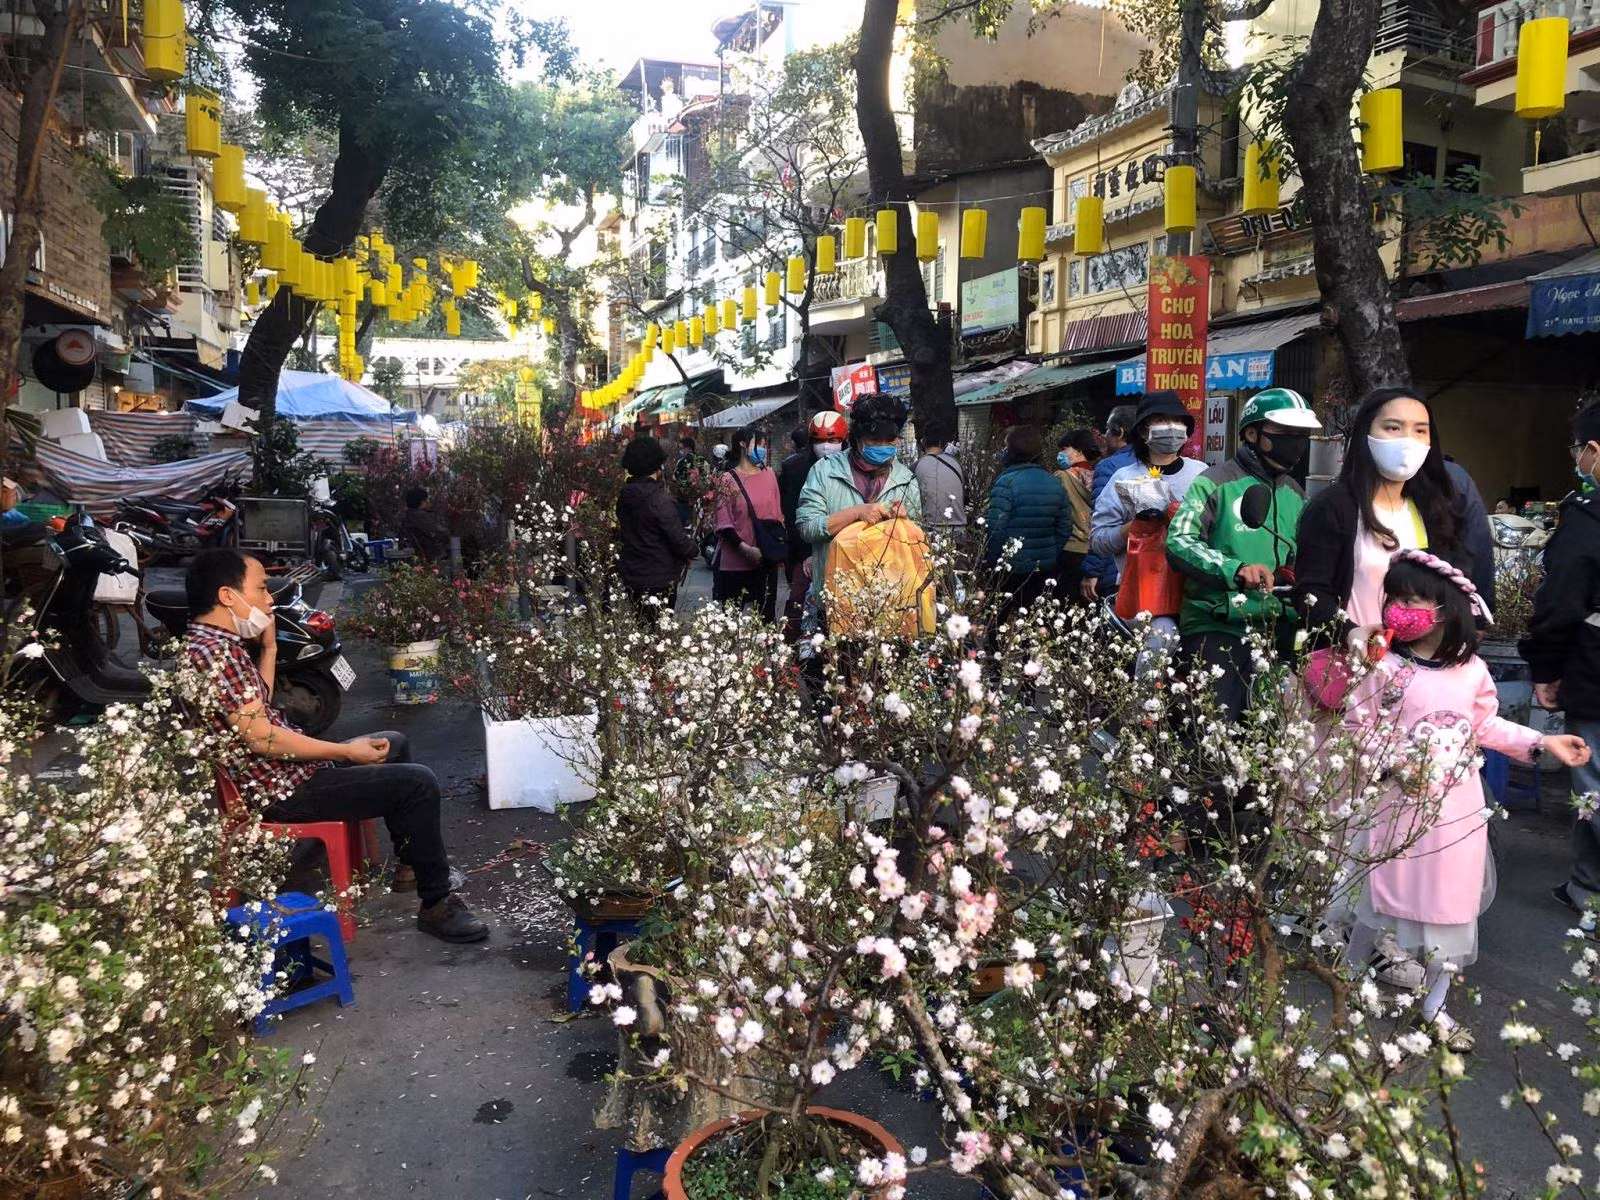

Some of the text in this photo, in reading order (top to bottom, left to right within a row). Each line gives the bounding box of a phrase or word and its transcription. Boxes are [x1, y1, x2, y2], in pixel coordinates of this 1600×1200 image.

[1161, 296, 1195, 318] CHỢ
[1160, 322, 1194, 340] HOA
[1153, 367, 1199, 390] THỐNG
[1208, 400, 1225, 424] LẨU
[1206, 431, 1225, 452] RIÊU
[1234, 522, 1259, 532] Gra
